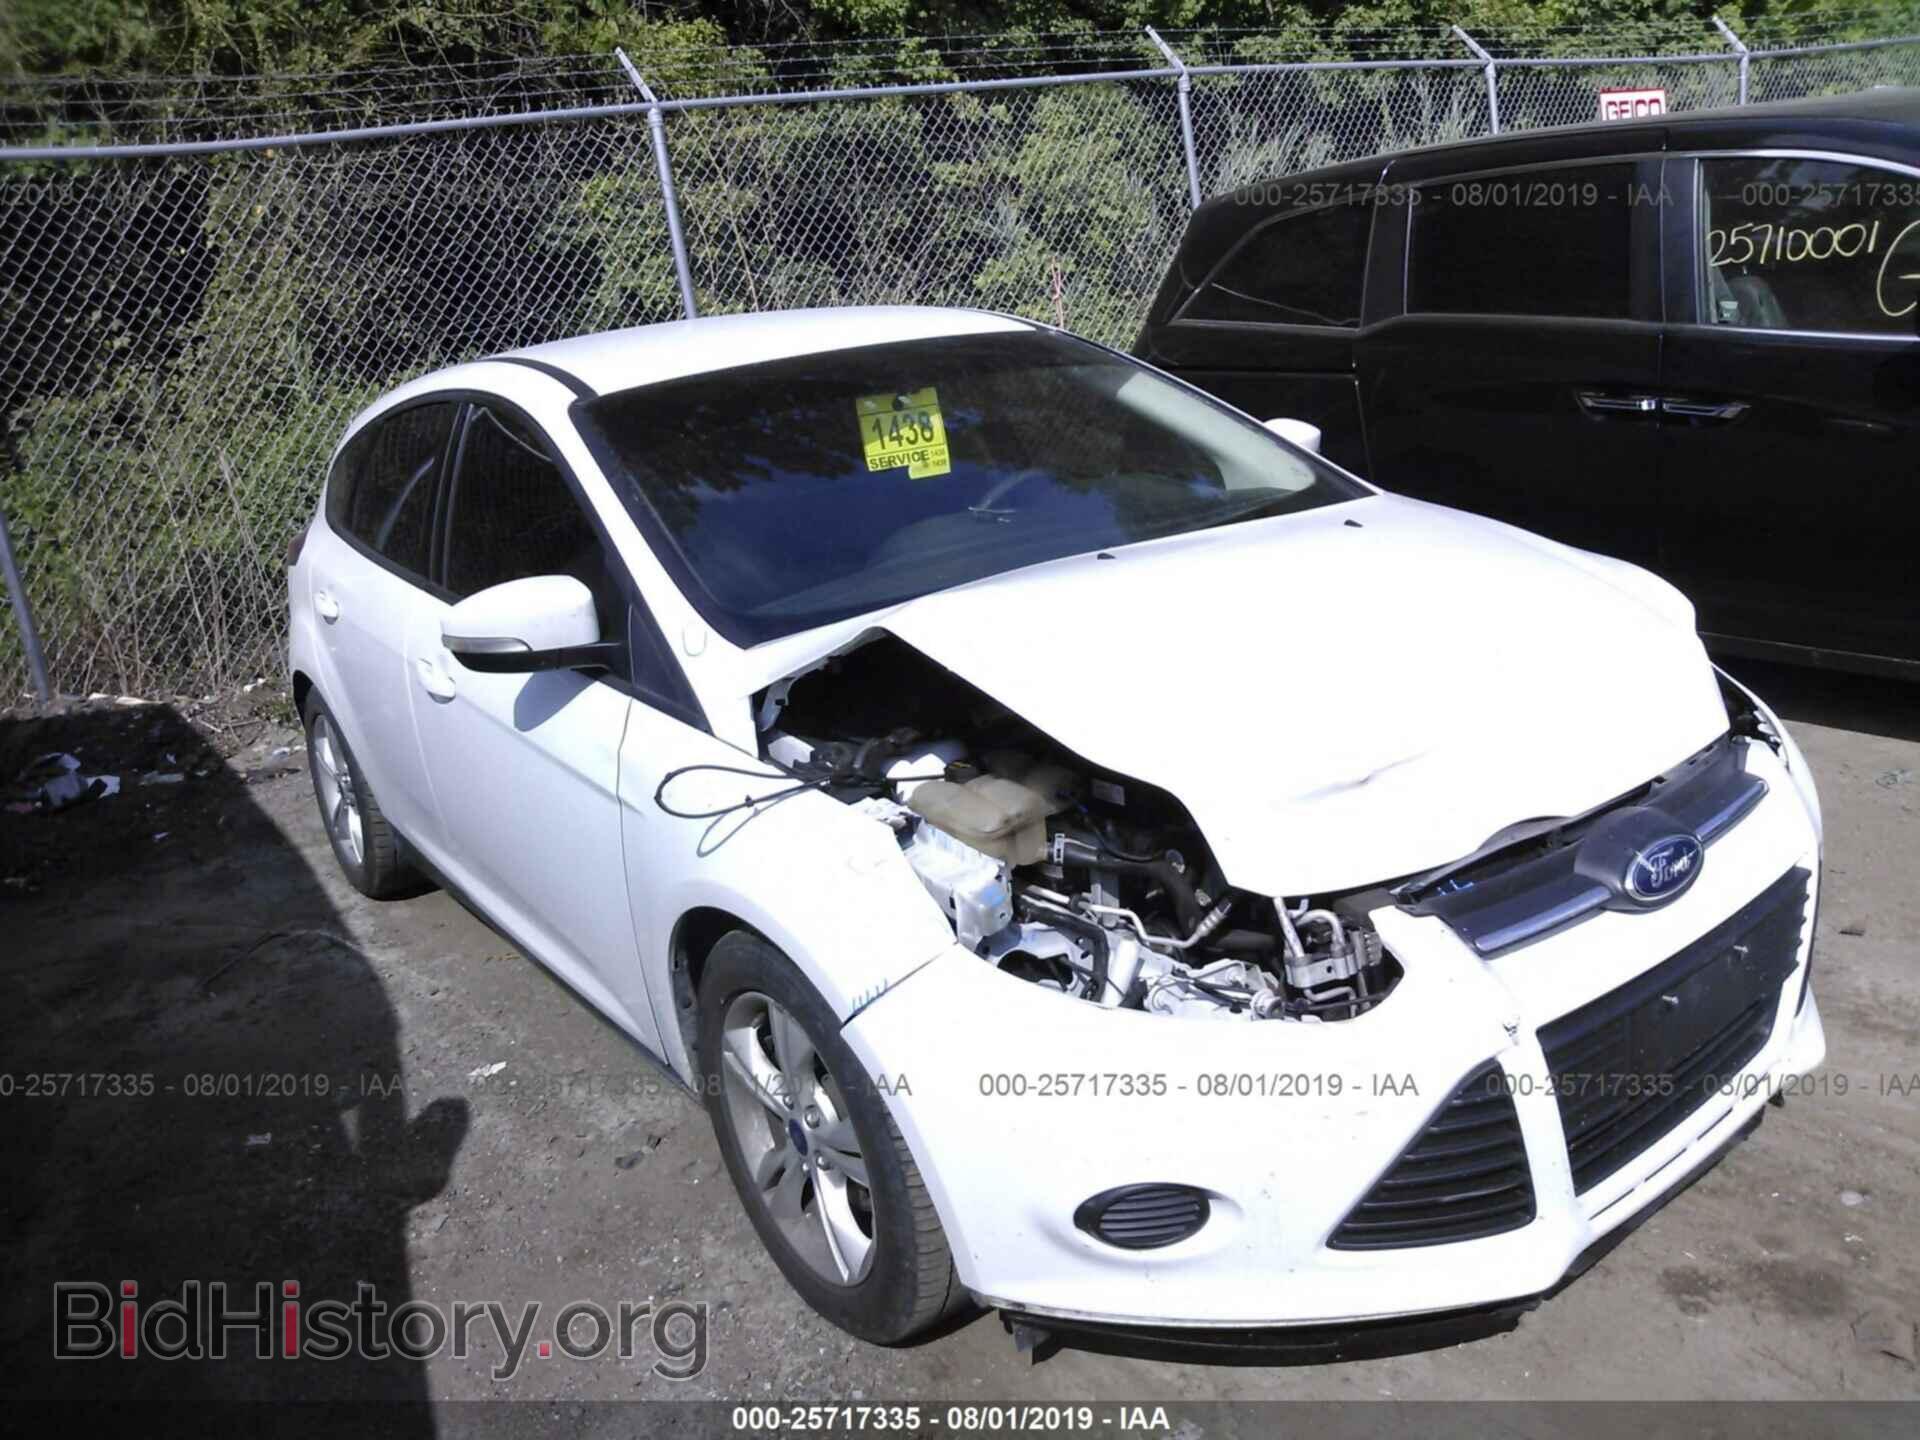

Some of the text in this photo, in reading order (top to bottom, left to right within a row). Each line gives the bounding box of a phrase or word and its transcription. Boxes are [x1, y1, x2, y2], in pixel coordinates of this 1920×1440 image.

[1607, 98, 1662, 120] GEICO
[1706, 220, 1880, 267] 25710001
[872, 410, 935, 451] 1438
[869, 449, 930, 470] SERVICE
[1647, 846, 1693, 888] Ford
